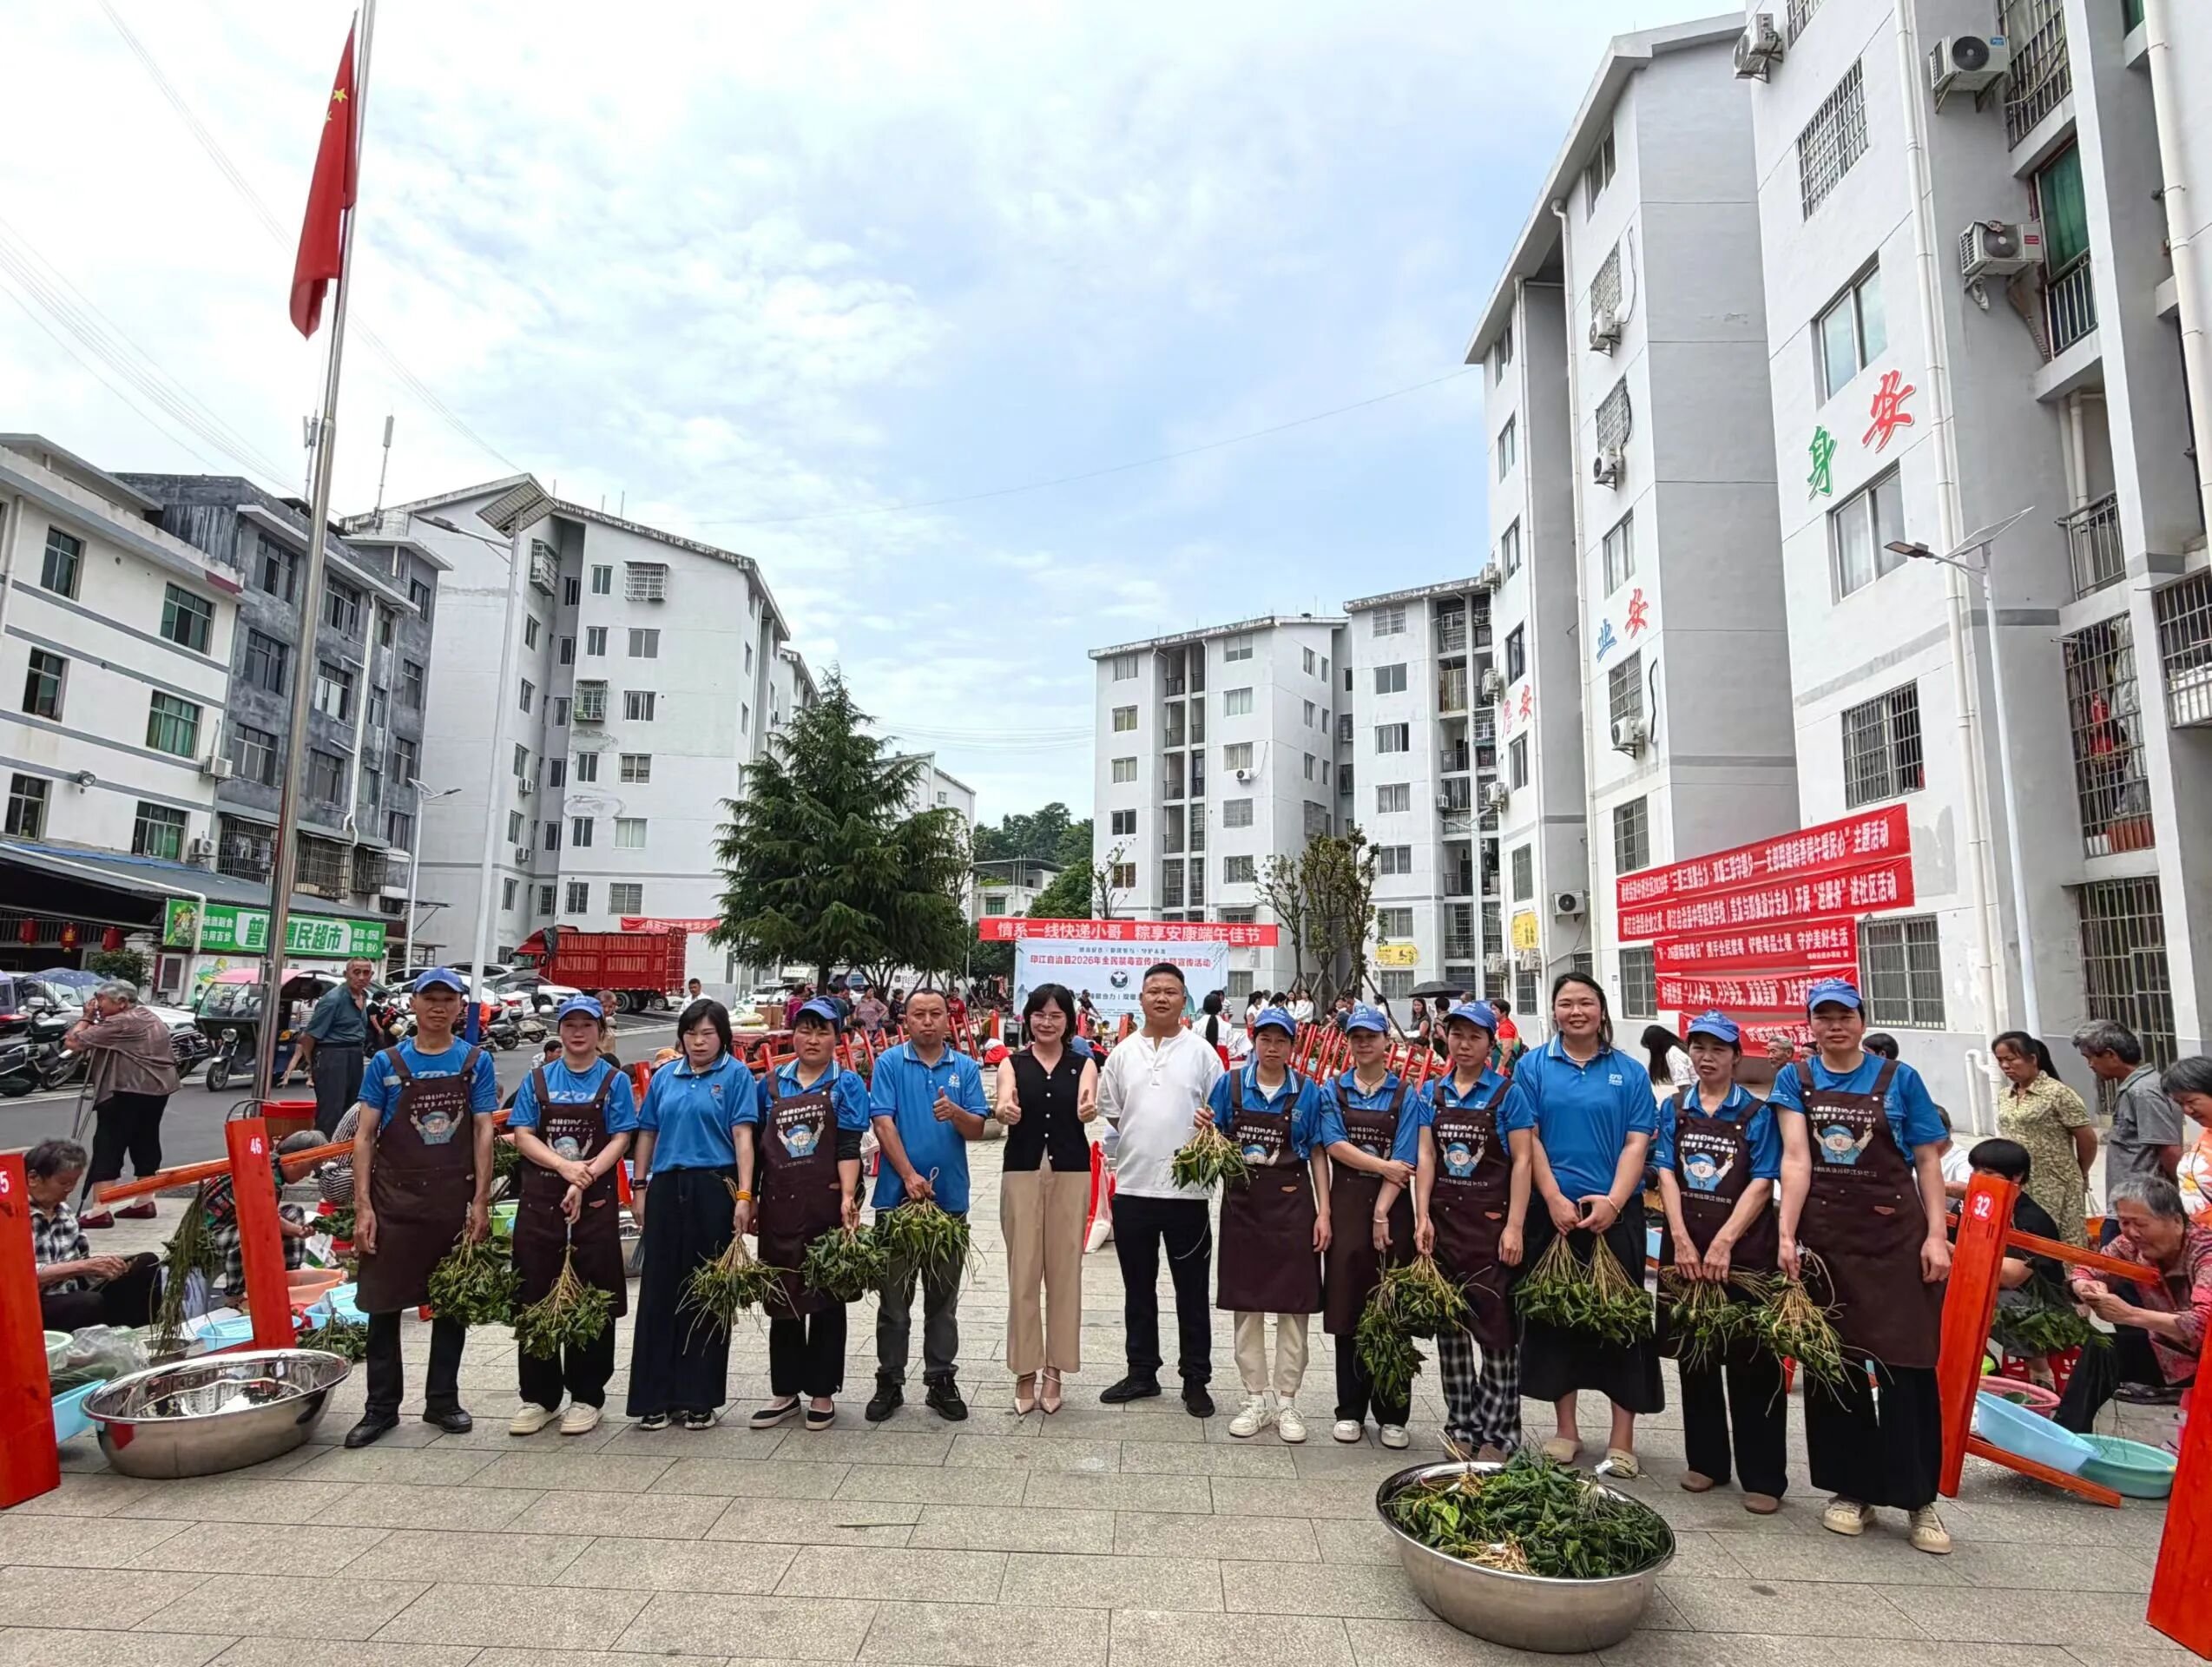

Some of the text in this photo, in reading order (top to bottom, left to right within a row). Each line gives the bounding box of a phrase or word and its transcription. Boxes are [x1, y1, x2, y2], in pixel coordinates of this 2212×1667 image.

[201, 931, 232, 942] 日用百货
[997, 922, 1261, 944] 情系一线快递小哥 粽享安康端午佳节
[1797, 926, 1848, 951] 守护美好生活
[250, 1137, 262, 1155] 46
[1974, 1196, 1991, 1217] 32
